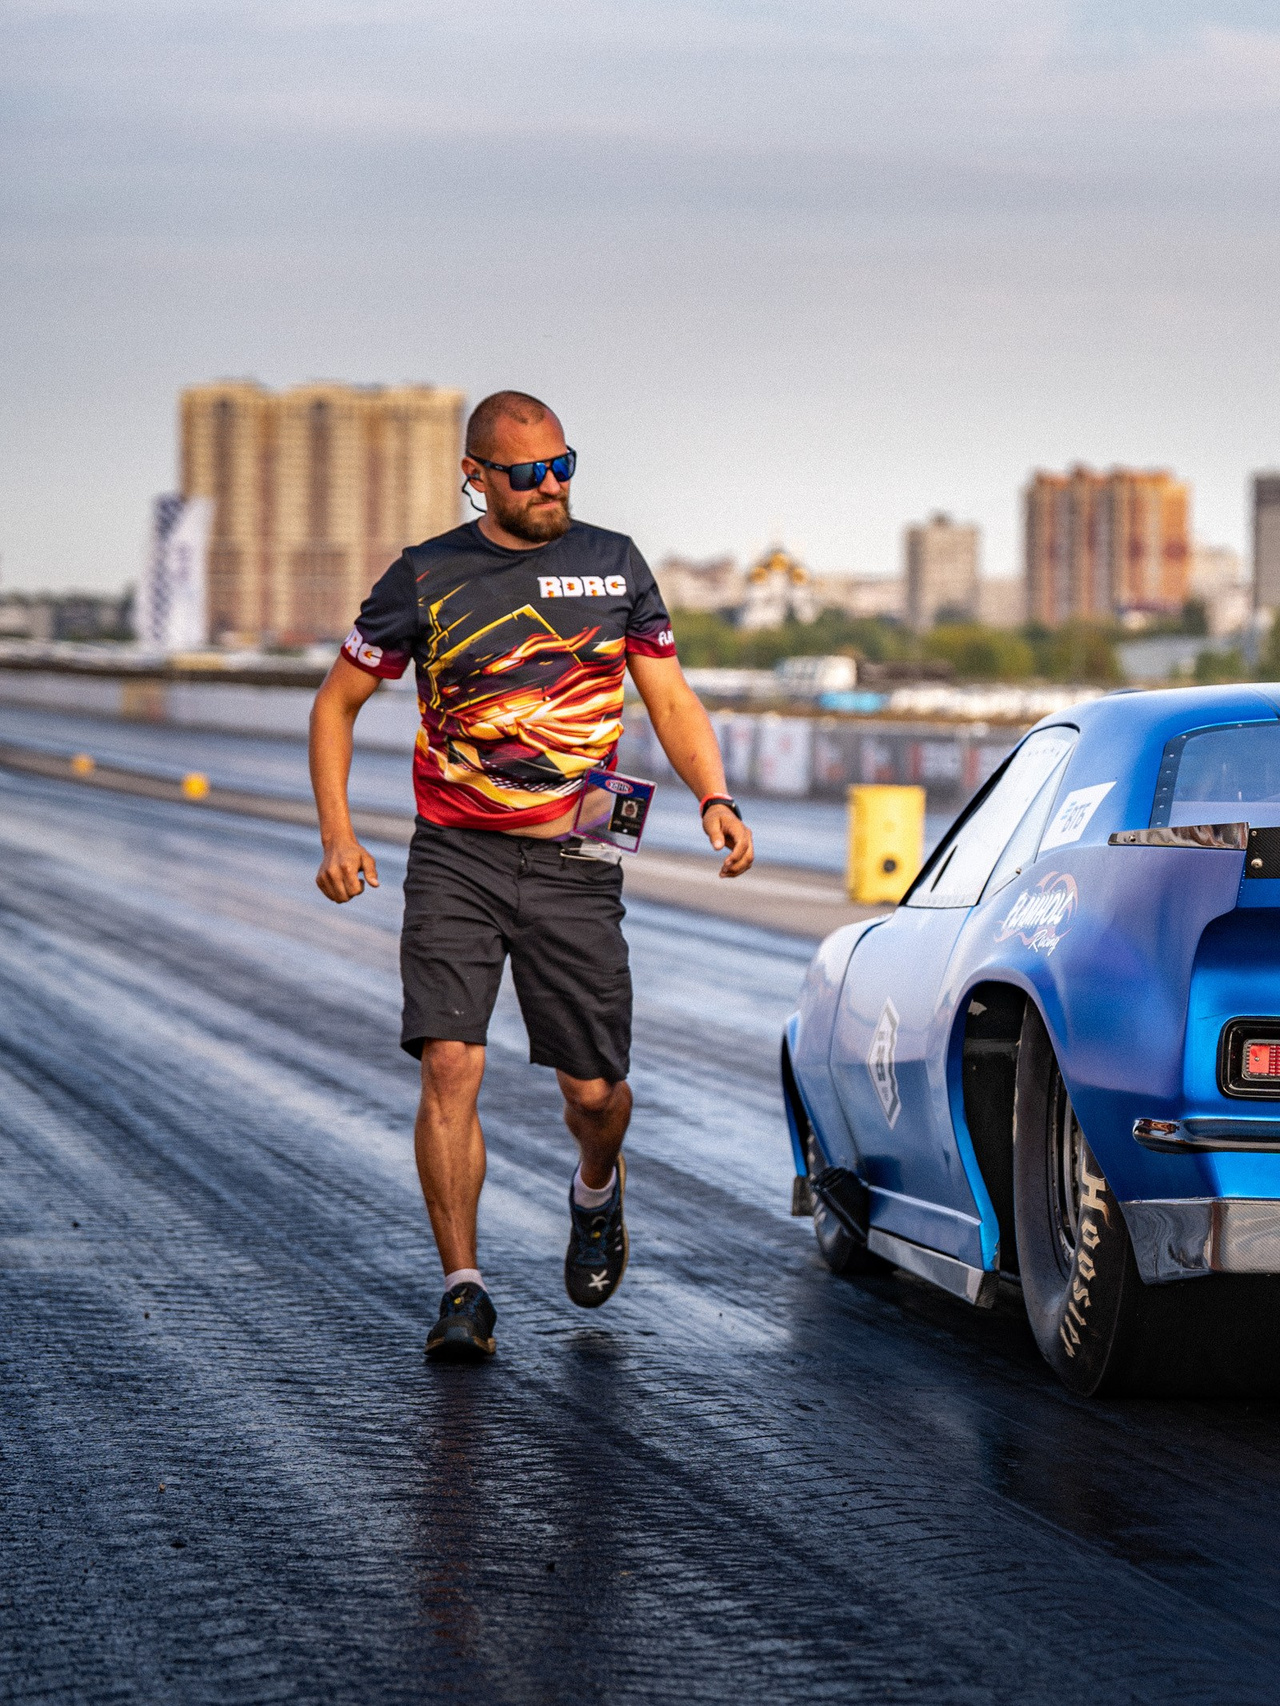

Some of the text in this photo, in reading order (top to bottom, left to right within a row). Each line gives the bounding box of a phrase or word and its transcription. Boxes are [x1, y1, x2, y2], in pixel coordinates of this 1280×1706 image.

[537, 575, 627, 598] RDRC
[1028, 929, 1060, 957] Racing
[1060, 1152, 1112, 1358] Hoosier
